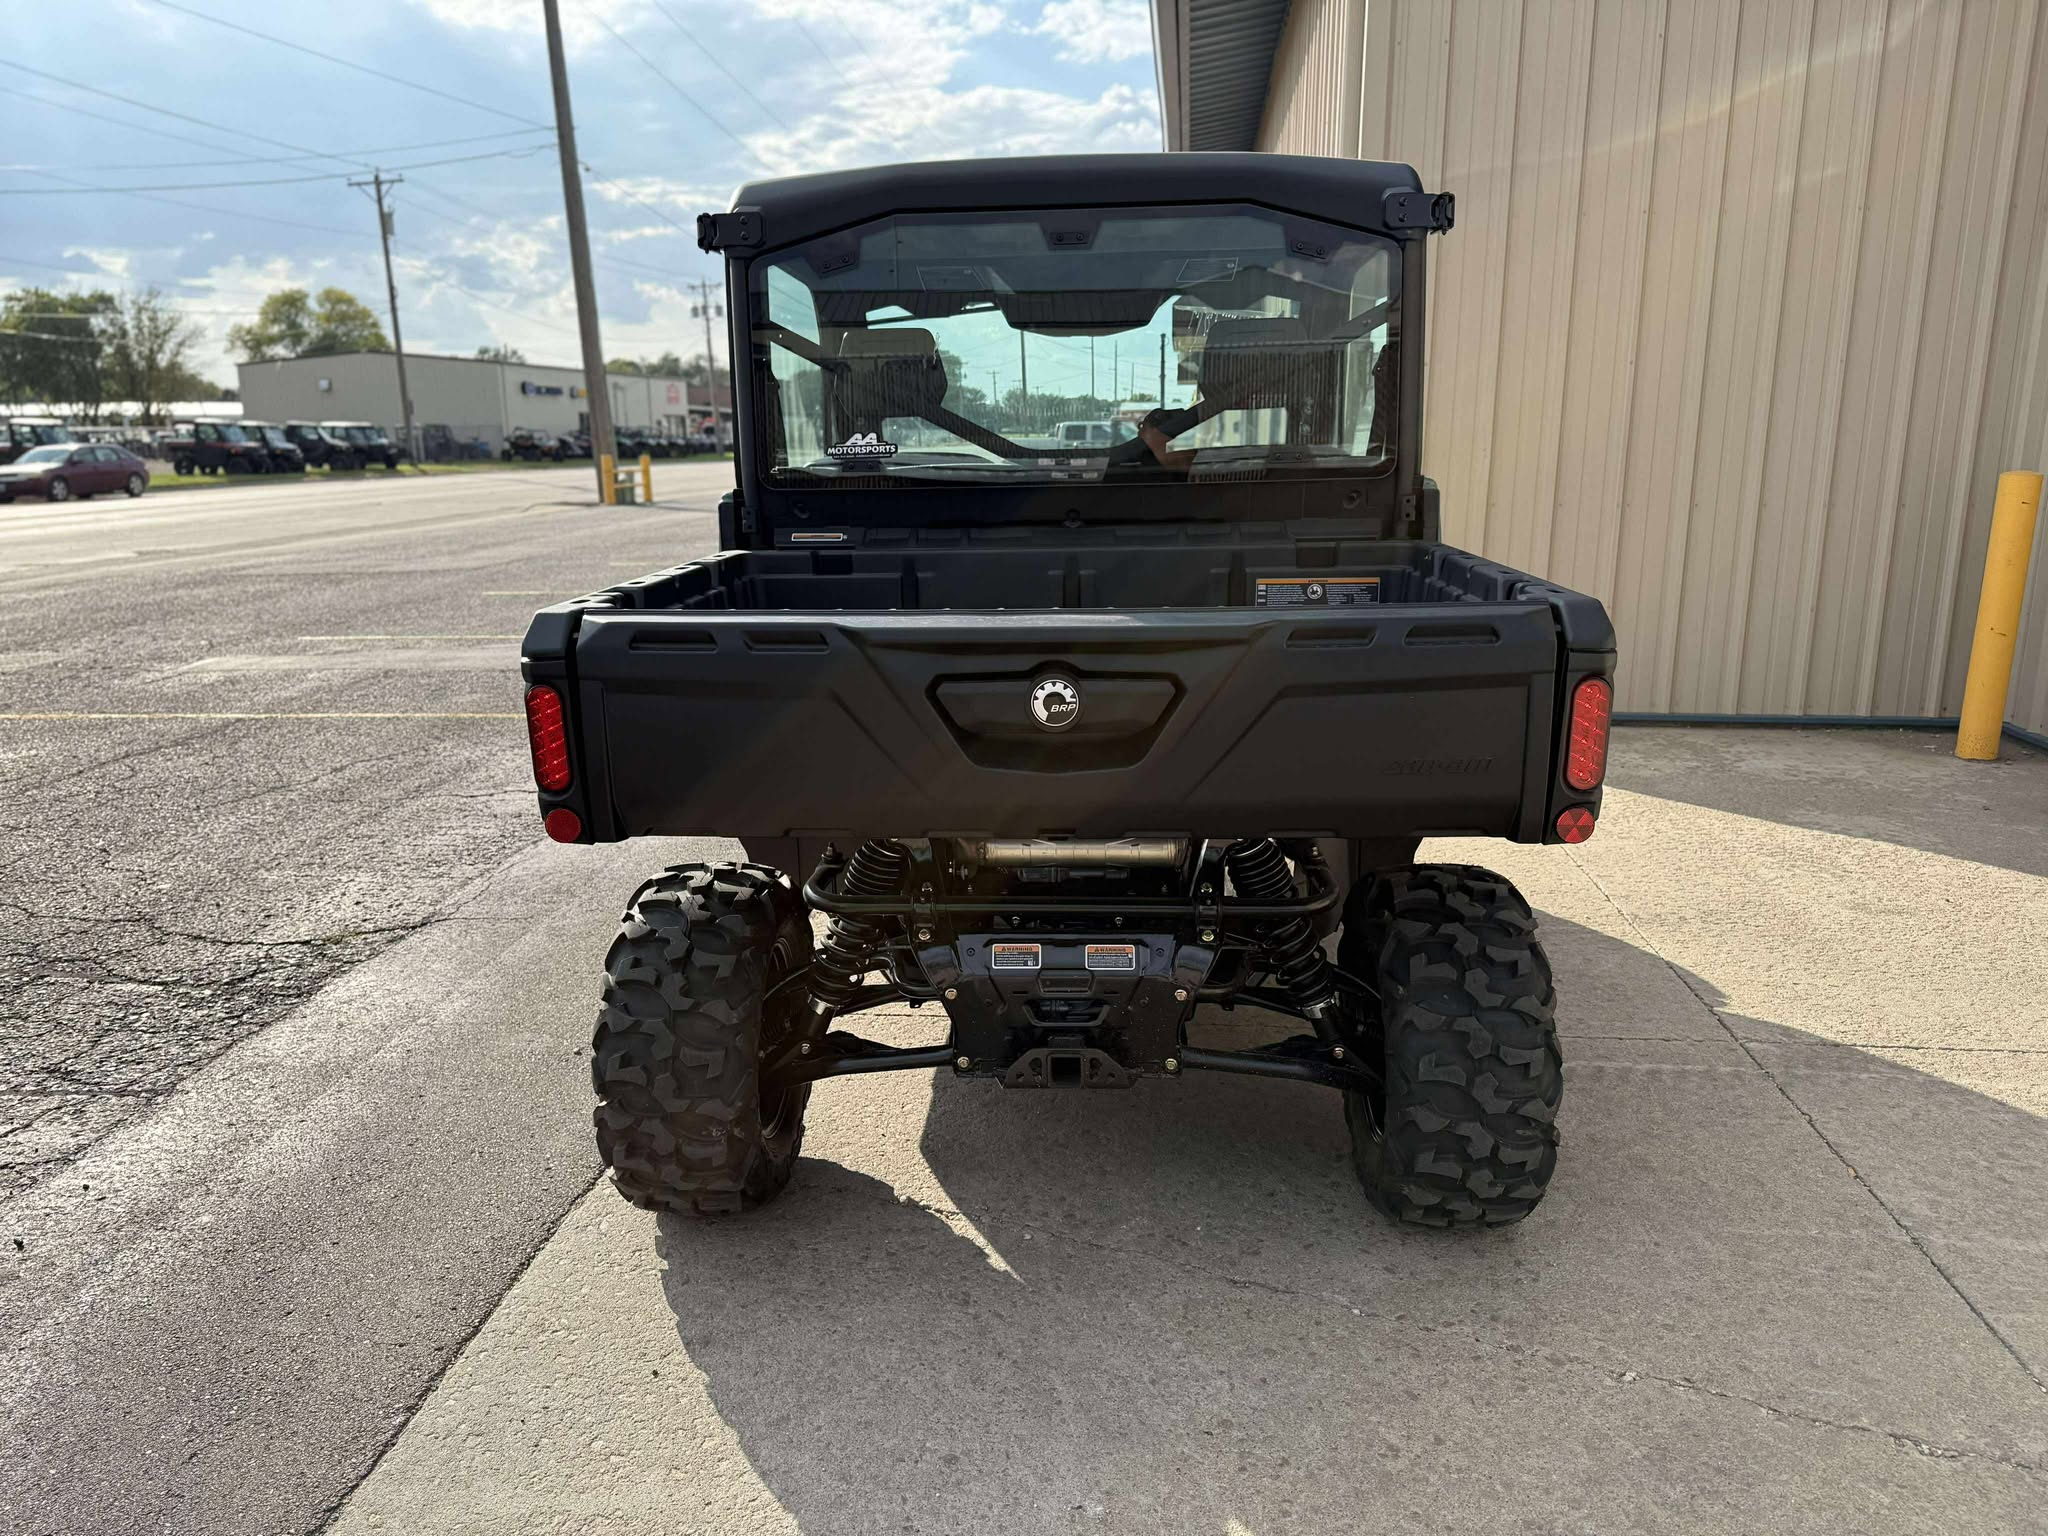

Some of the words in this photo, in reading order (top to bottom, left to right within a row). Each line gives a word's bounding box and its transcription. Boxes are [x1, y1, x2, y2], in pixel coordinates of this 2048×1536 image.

[844, 432, 878, 445] AA
[827, 445, 896, 455] MOTORSPORTS
[1050, 703, 1076, 713] BRP
